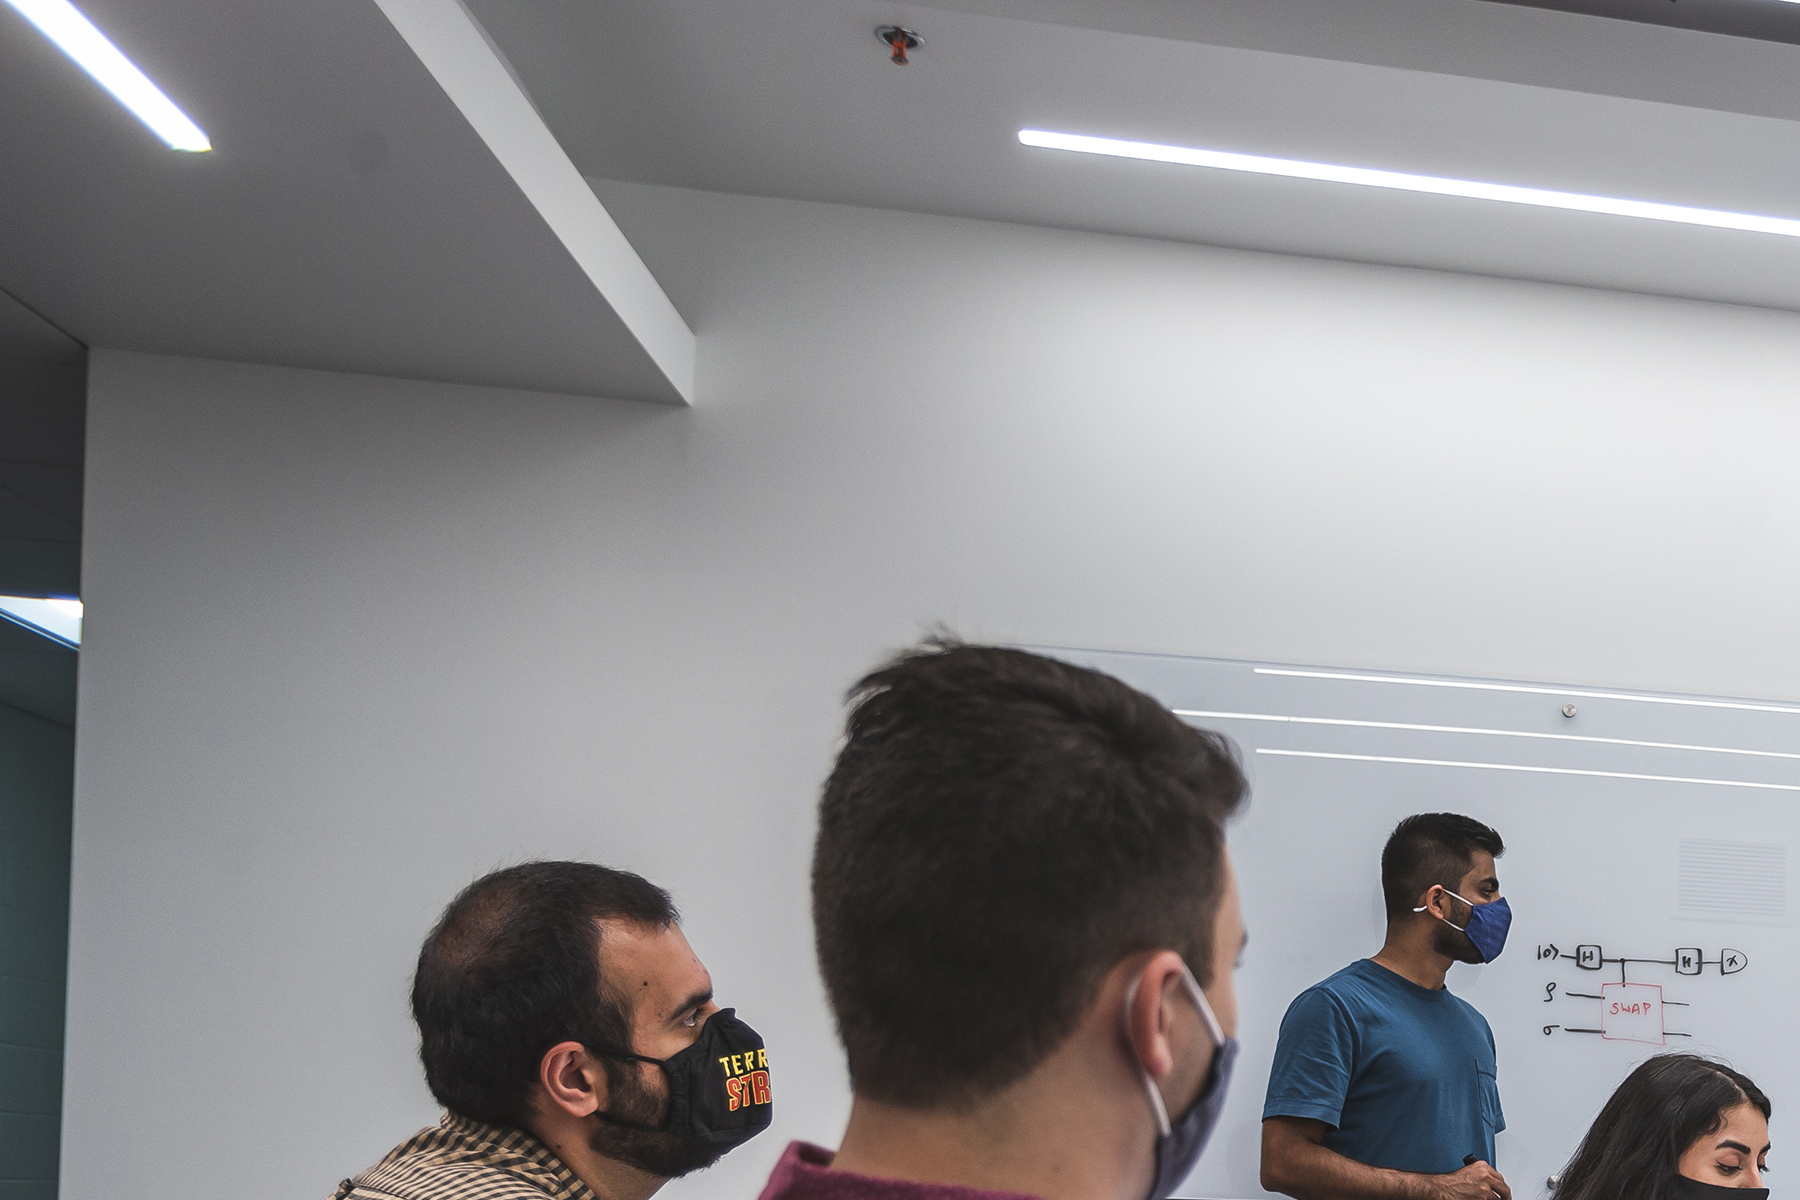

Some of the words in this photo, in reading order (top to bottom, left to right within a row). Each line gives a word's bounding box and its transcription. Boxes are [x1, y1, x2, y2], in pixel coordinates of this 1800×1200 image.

[1582, 950, 1594, 963] H
[1682, 955, 1692, 968] H
[1609, 1002, 1651, 1015] SWAP
